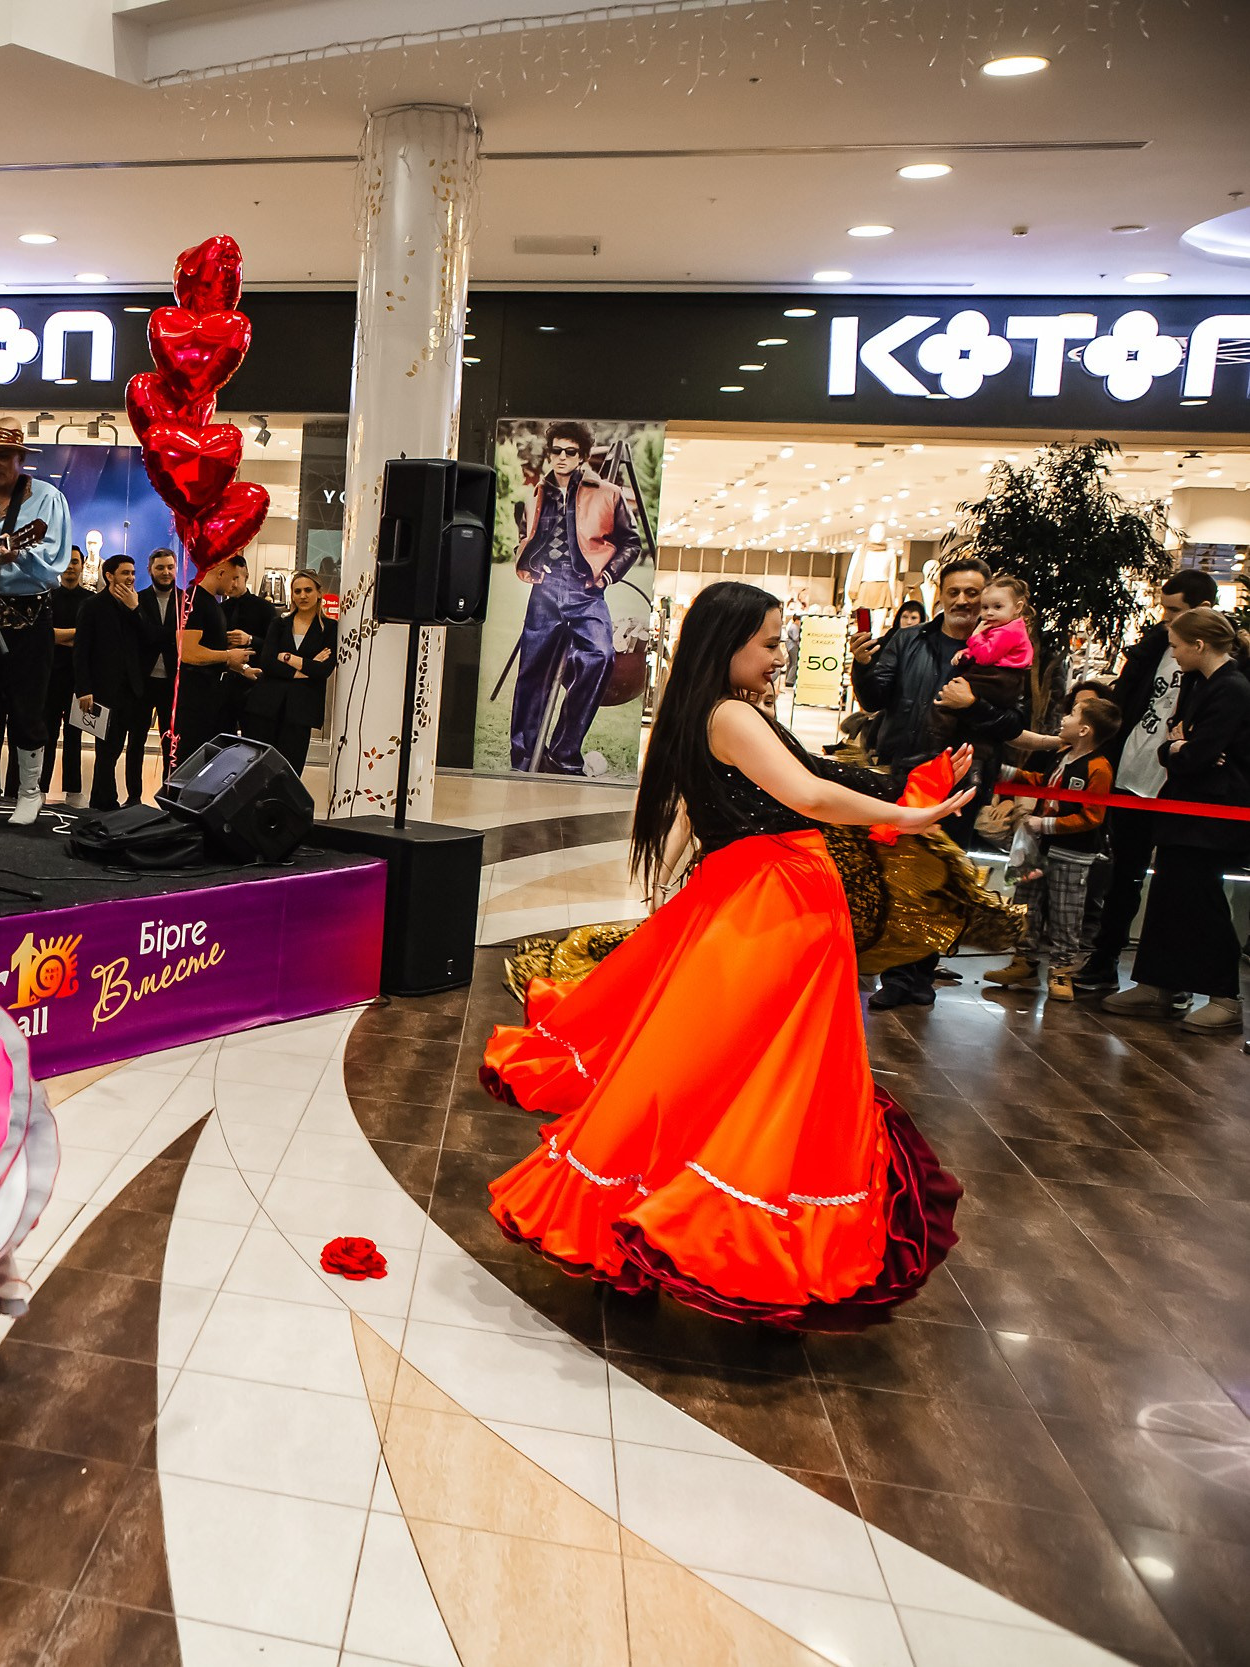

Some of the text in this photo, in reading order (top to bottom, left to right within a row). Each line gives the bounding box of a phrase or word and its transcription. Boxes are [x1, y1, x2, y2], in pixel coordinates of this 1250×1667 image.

[139, 918, 208, 959] Бірге
[90, 942, 226, 1033] Вместе
[17, 1005, 49, 1037] all
